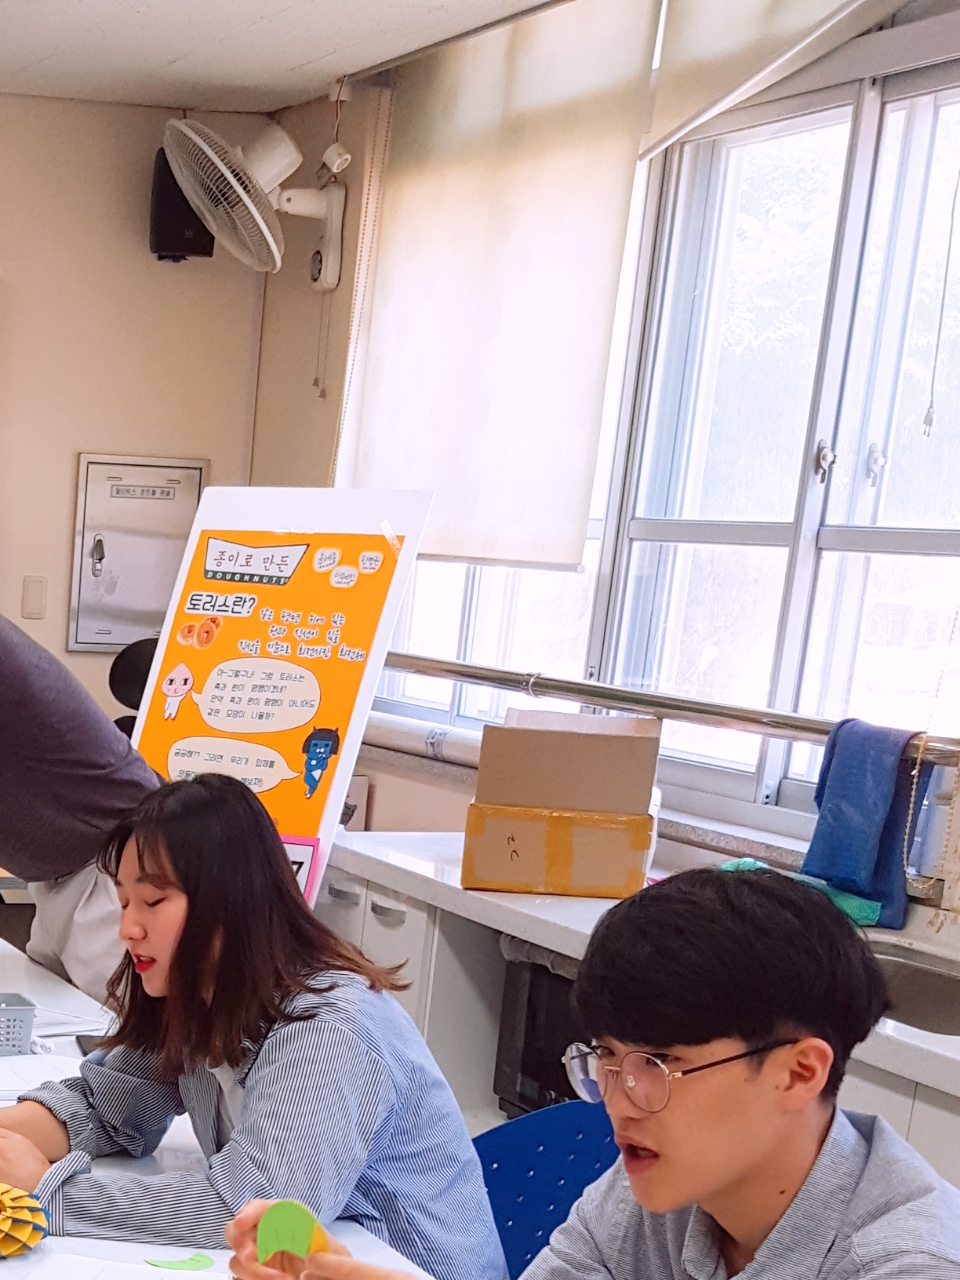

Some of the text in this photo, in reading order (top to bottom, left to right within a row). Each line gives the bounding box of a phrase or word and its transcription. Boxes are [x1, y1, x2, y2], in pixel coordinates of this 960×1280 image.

[213, 550, 289, 573] 종이로 만든
[207, 571, 285, 585] DOUGHNUTS
[186, 593, 256, 615] 토러스란?
[260, 608, 346, 626] 같은 평면 위에 있는
[295, 628, 319, 640] 직선이
[239, 640, 366, 661] 직선을 기준으로 회전시킨 회전체
[288, 699, 316, 709] 아니어도
